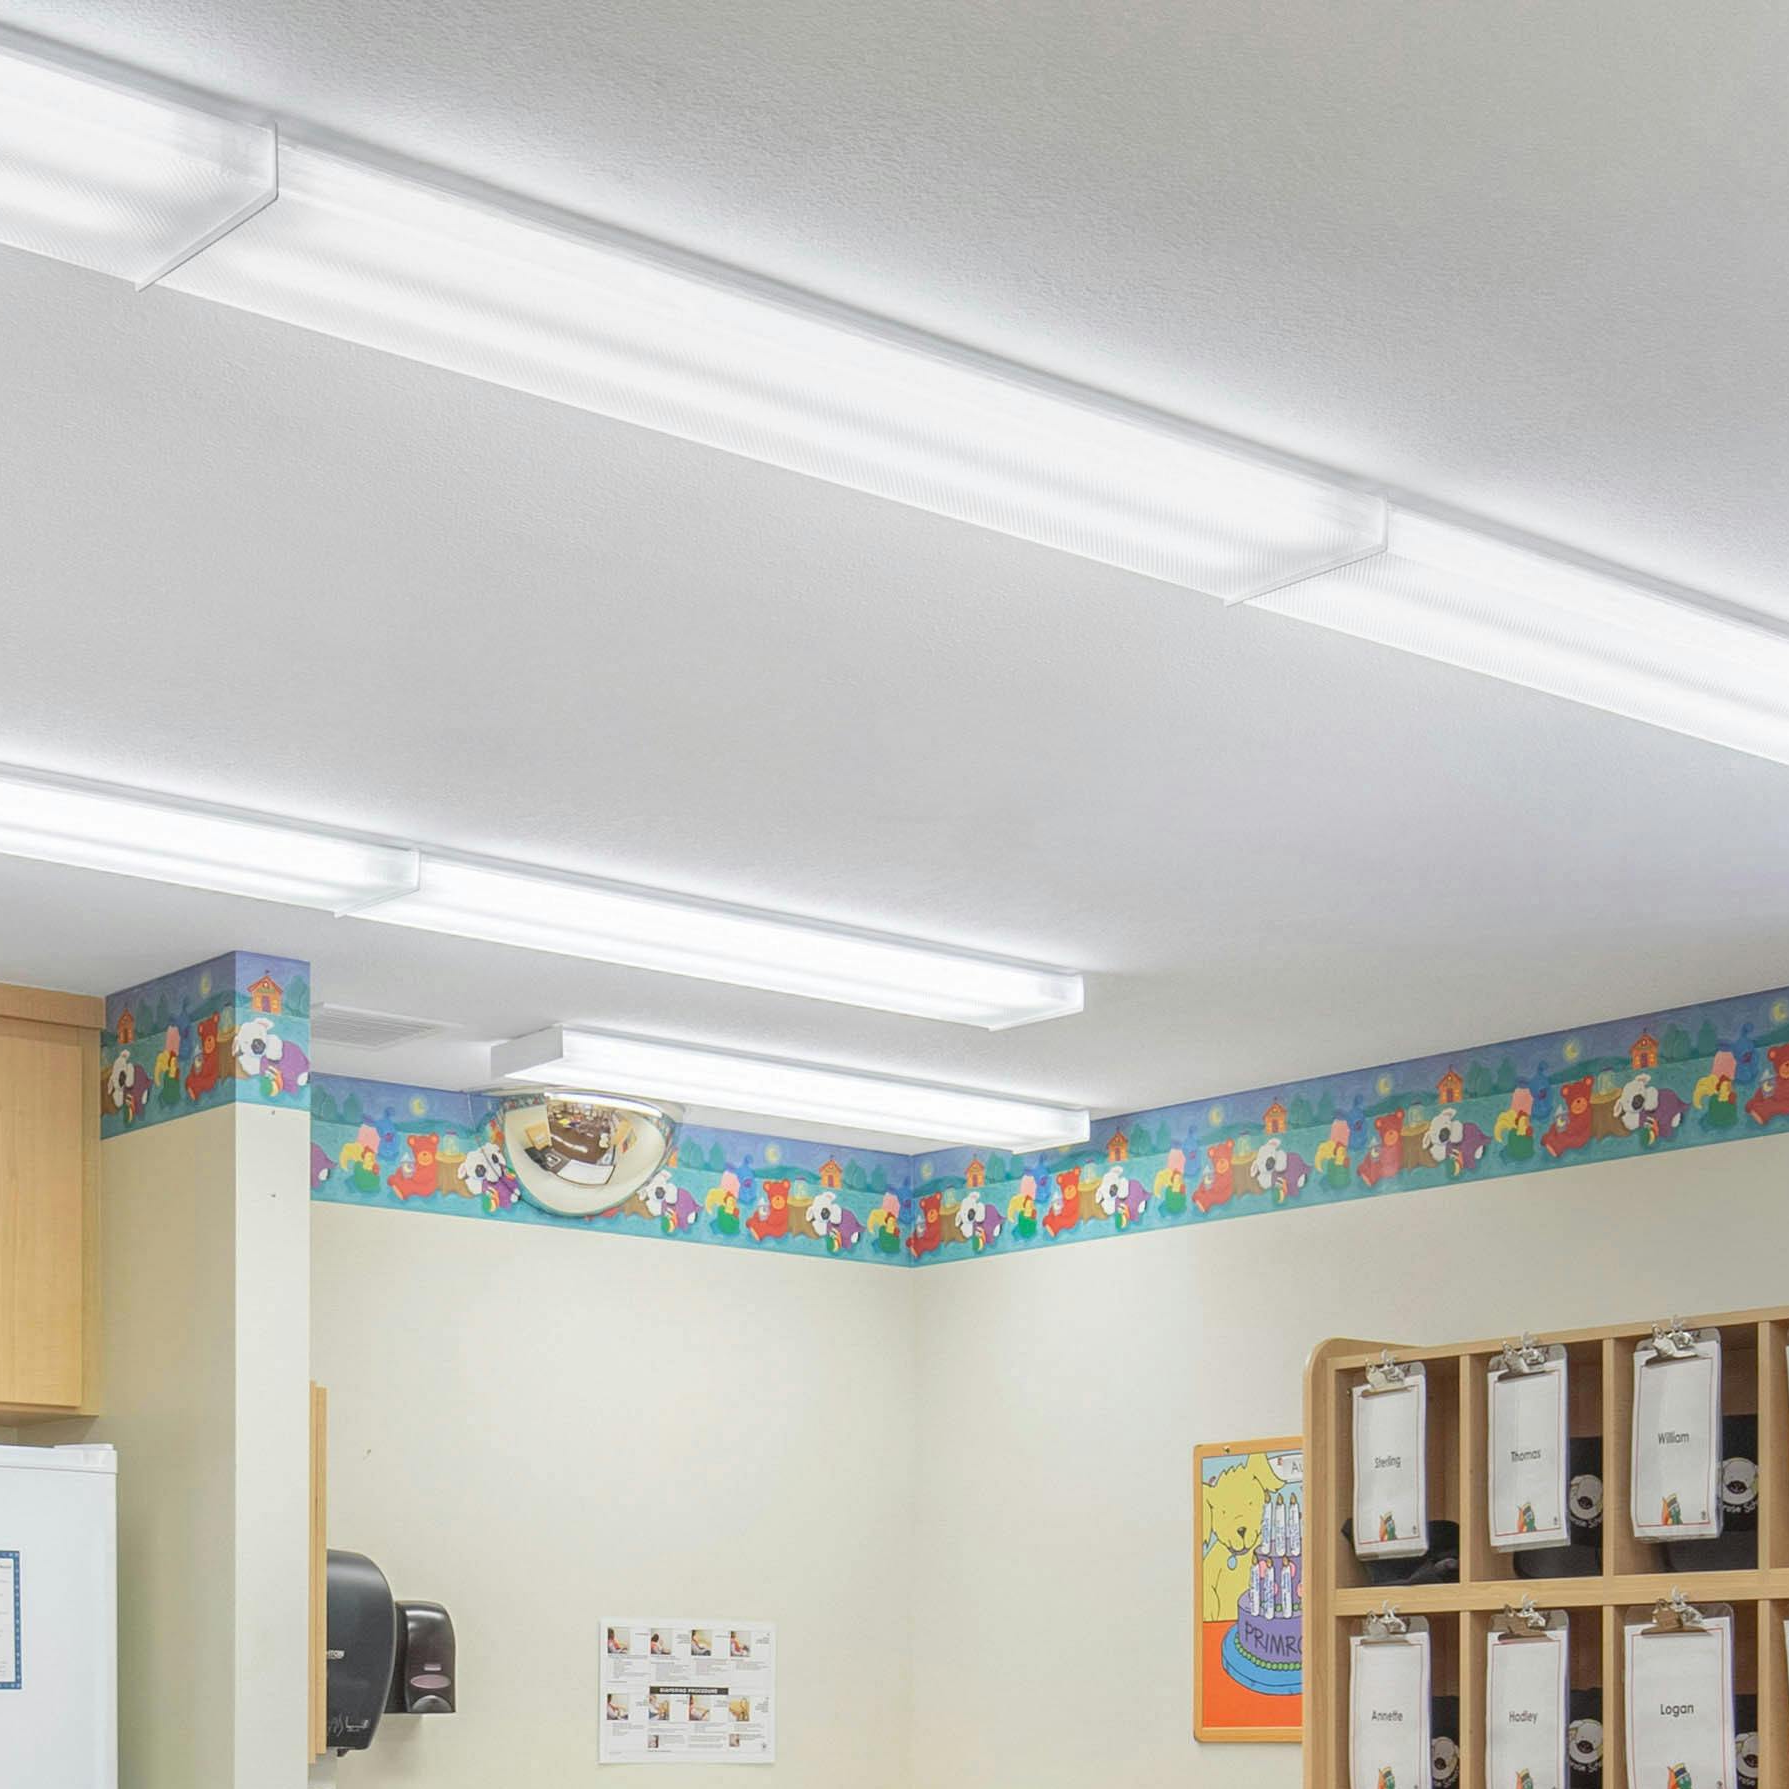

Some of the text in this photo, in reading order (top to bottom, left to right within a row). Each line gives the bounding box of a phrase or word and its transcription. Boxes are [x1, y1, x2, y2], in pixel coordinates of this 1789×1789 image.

[1658, 1431, 1689, 1444] William
[1375, 1455, 1401, 1469] Sterling
[1511, 1449, 1542, 1462] Thomas
[1371, 1710, 1403, 1722] Annette
[1660, 1704, 1694, 1718] Logan
